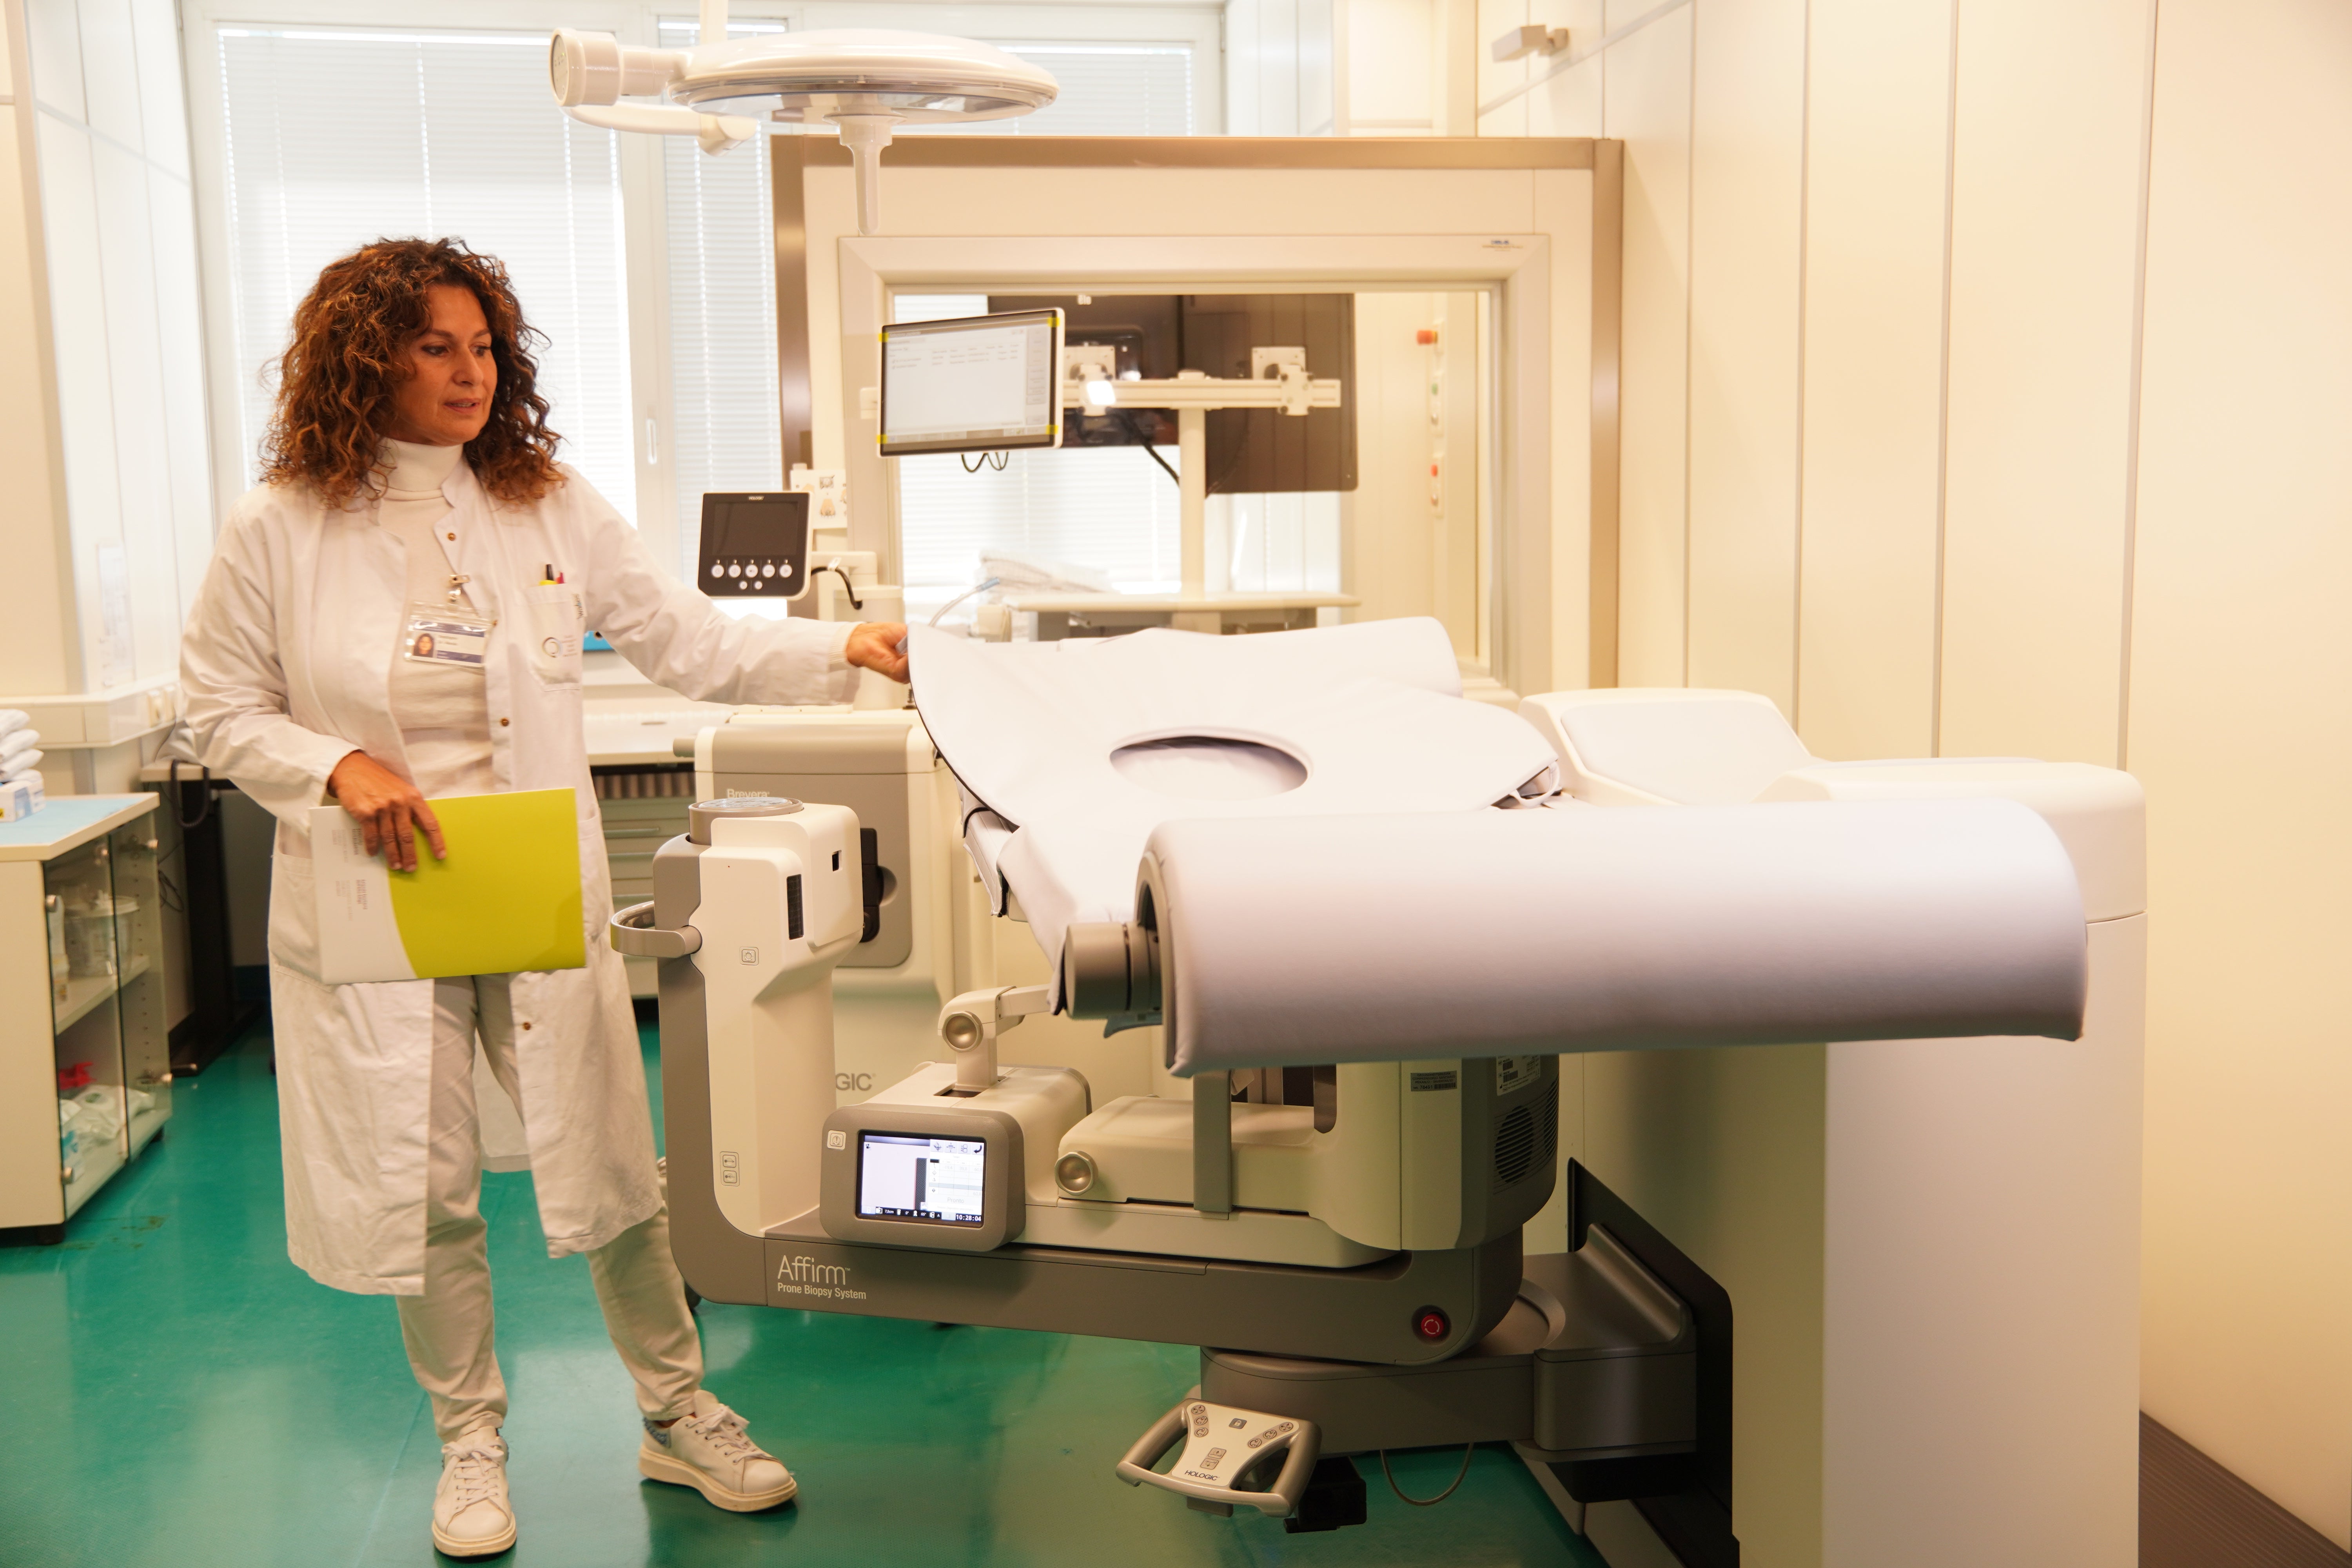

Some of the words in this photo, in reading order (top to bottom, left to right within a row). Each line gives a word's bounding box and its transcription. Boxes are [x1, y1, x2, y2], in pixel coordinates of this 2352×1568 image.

[778, 1282, 802, 1293] Prone
[804, 1285, 832, 1298] Biopsy
[835, 1288, 866, 1299] System
[1185, 1470, 1218, 1481] HOLOGIC
